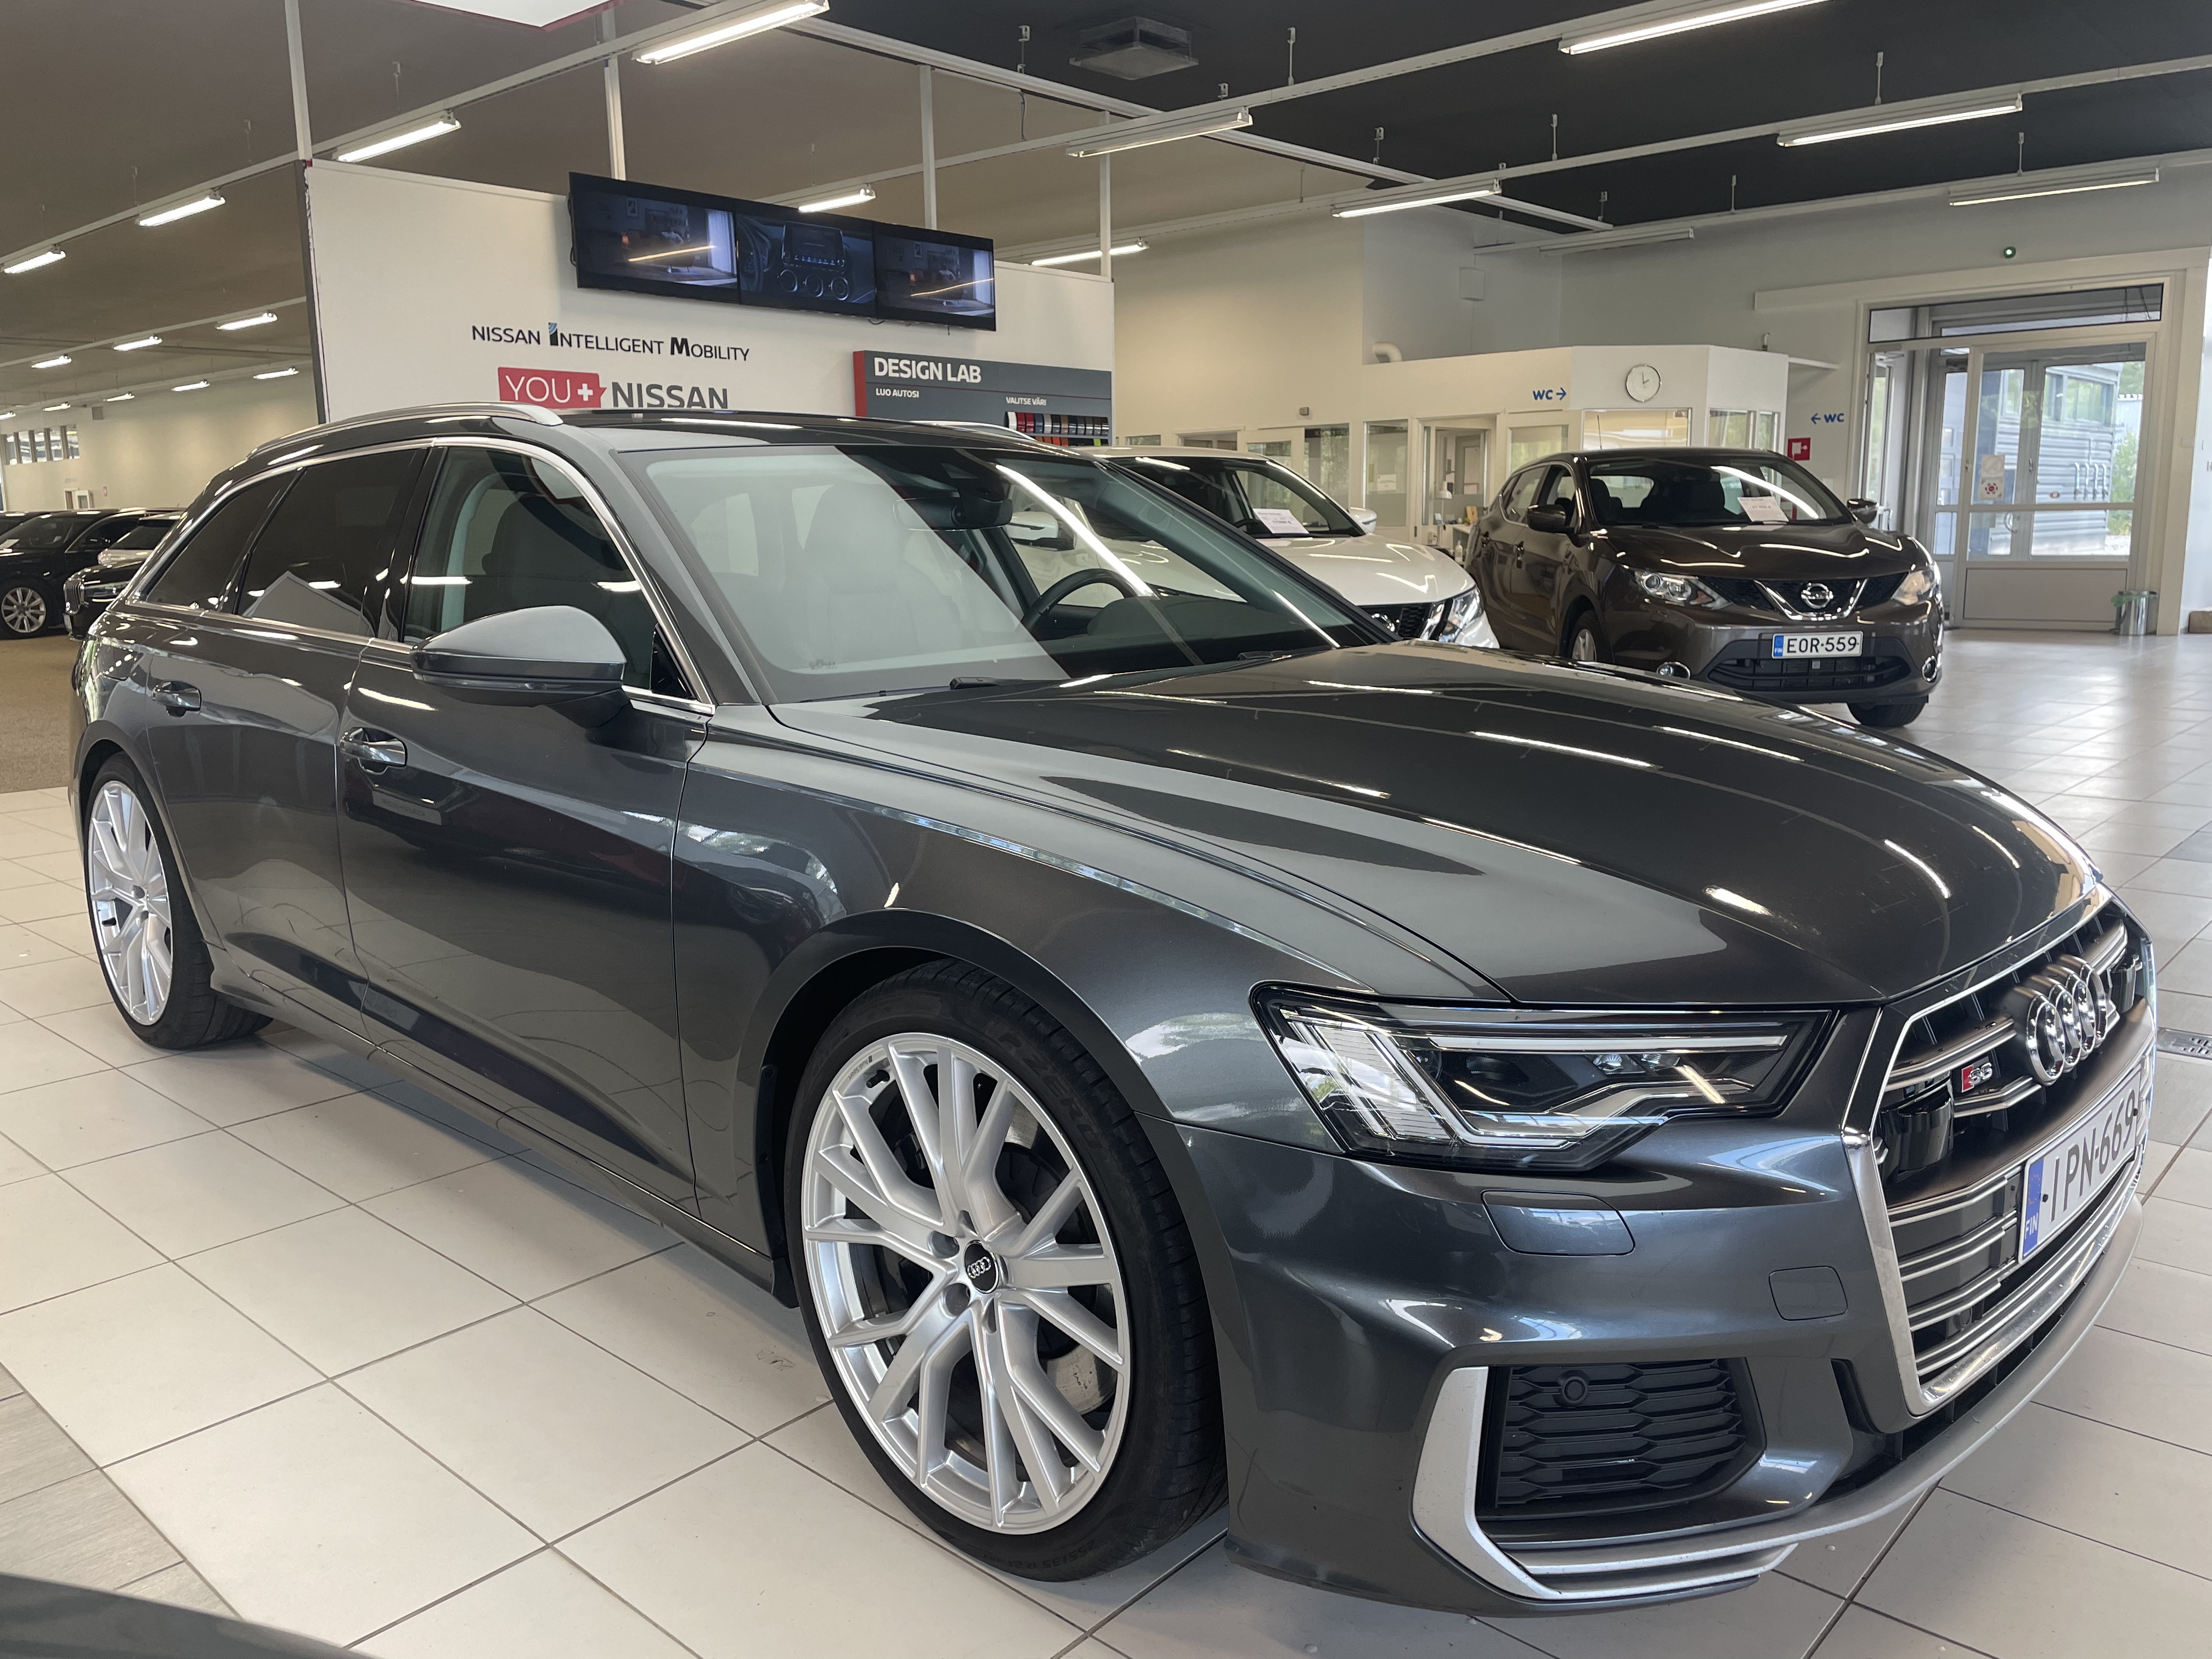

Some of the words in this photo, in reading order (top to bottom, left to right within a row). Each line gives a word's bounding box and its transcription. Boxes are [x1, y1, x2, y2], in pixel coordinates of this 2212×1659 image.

[472, 325, 540, 345] NISSAN
[549, 322, 664, 354] INTELLIGENT
[670, 337, 749, 361] MOBILITY
[874, 357, 943, 381] DESIGN
[947, 364, 981, 383] LAB
[612, 382, 728, 409] NISSAN
[876, 388, 891, 396] LUO
[893, 389, 919, 398] AUTOSI
[1006, 397, 1032, 406] VALITSE
[1032, 397, 1047, 406] VÄRI
[1533, 390, 1553, 400] WC
[1824, 413, 1844, 423] WC
[1786, 636, 1857, 653] EOR-559
[859, 1059, 868, 1069] Audi
[848, 1067, 860, 1080] Sport
[1968, 1062, 1993, 1086] S6
[2051, 1089, 2135, 1222] IPN-669
[2024, 1212, 2038, 1240] FIN
